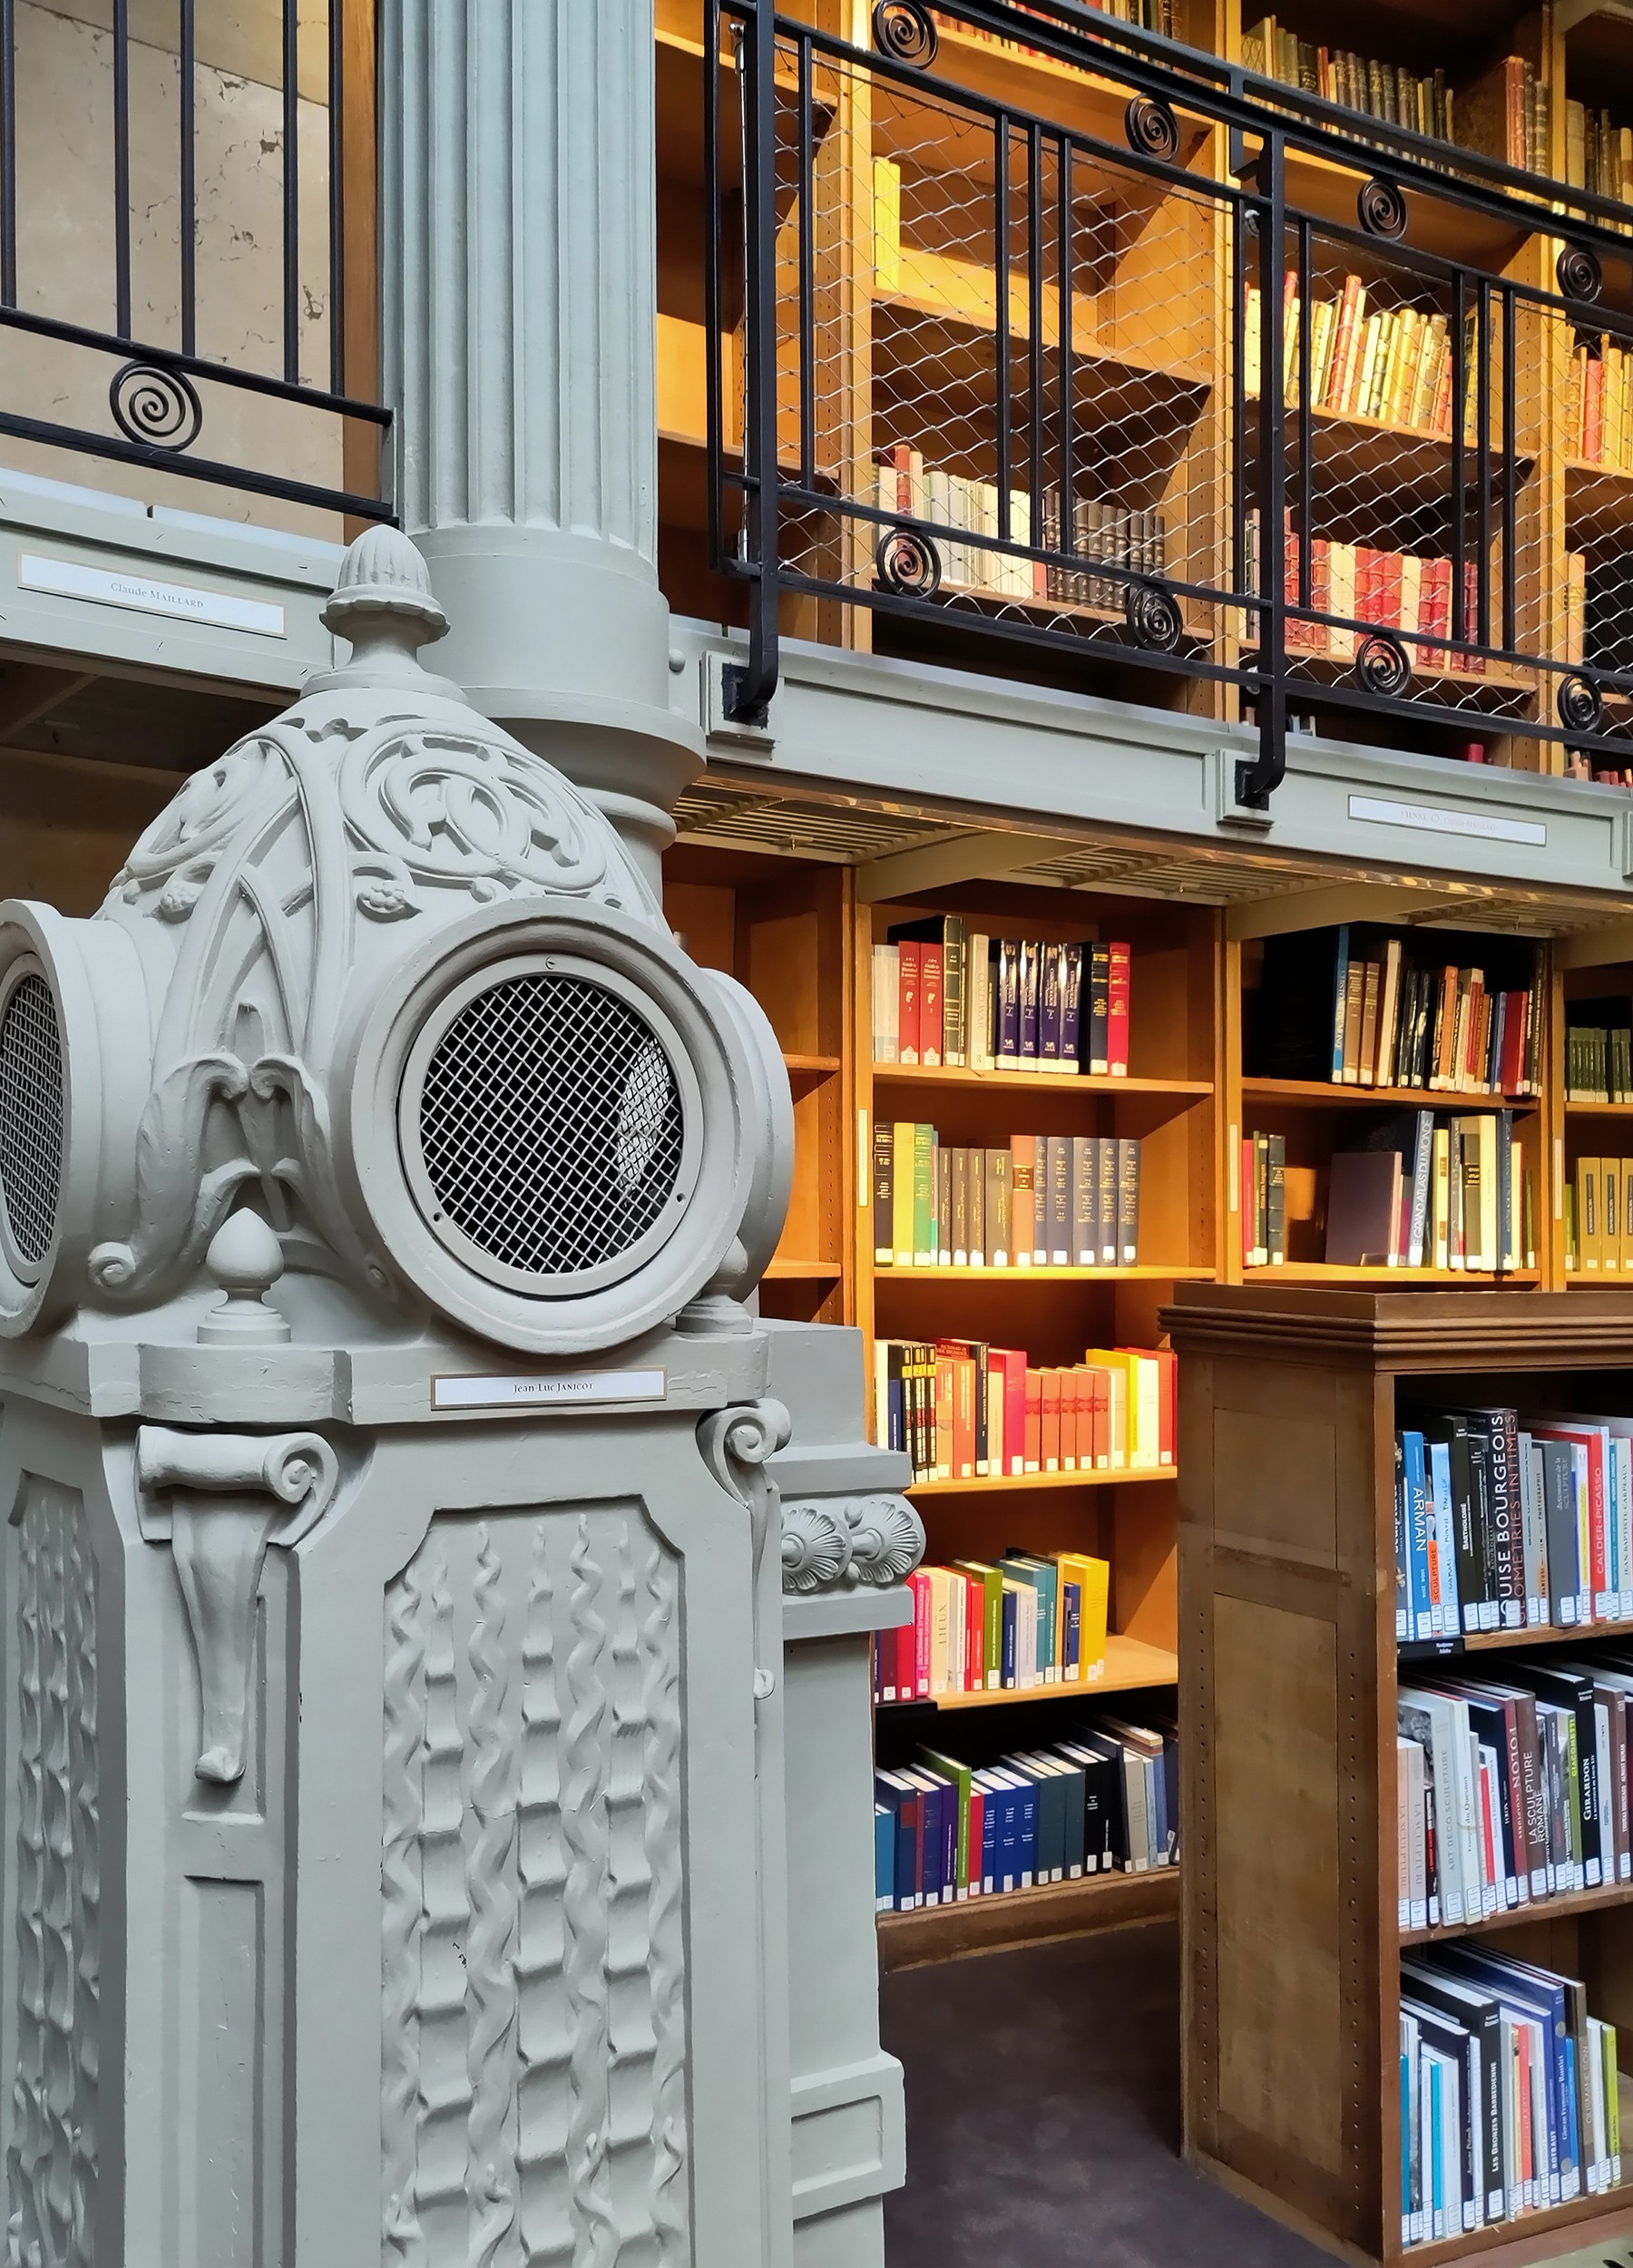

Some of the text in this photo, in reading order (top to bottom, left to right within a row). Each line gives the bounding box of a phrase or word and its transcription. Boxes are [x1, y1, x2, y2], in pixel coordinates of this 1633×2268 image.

[111, 582, 204, 608] Claude MAILLARD
[1421, 1119, 1433, 1158] MONDE
[1416, 1174, 1427, 1202] ATLAS
[1418, 1158, 1428, 1173] DU
[1413, 1203, 1424, 1238] GRAND
[513, 1383, 593, 1394] Jean-Luc JANICOT
[1491, 1415, 1510, 1541] BOURGEOIS
[1505, 1414, 1520, 1492] INTIMES
[1413, 1487, 1427, 1551] ARMAN
[1594, 1467, 1604, 1575] CALDER-PICASSO
[1431, 1549, 1440, 1600] SCULPTURE
[938, 1603, 947, 1645] LIEUX
[1510, 1726, 1521, 1789] FOLON
[1569, 1719, 1578, 1777] GIACOMETTI
[1442, 1751, 1452, 1812] SCULPTURE
[1523, 1751, 1538, 1845] LA SCULPTURE
[1583, 1757, 1592, 1821] GIRARDON
[1534, 1790, 1545, 1843] ROMANE
[1414, 1820, 1423, 1885] SCULPTURE
[1446, 1851, 1454, 1871] ART
[1490, 2062, 1498, 2116] BARBEDIENNE
[1491, 2117, 1499, 2155] BRONZES
